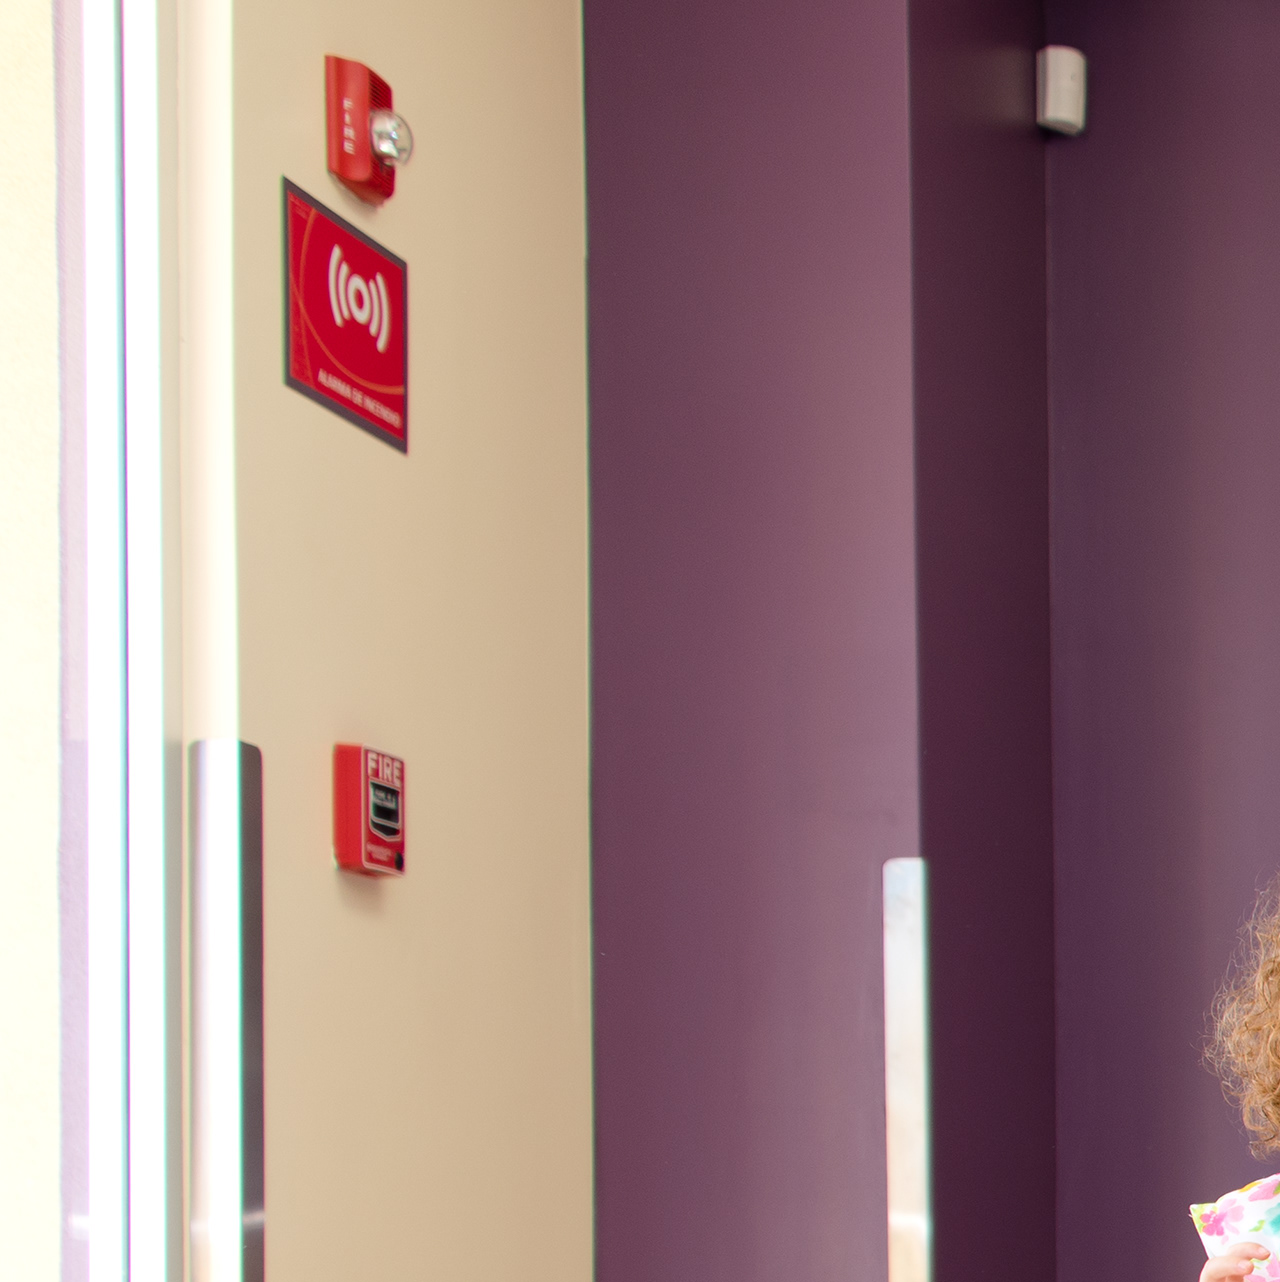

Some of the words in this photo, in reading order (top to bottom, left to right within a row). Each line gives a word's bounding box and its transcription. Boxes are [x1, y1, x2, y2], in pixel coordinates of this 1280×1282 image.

[343, 97, 355, 155] FIRE
[317, 368, 352, 401] ALARMA
[352, 387, 364, 408] DE
[363, 393, 401, 430] INCENDIO
[367, 750, 402, 787] FIRE
